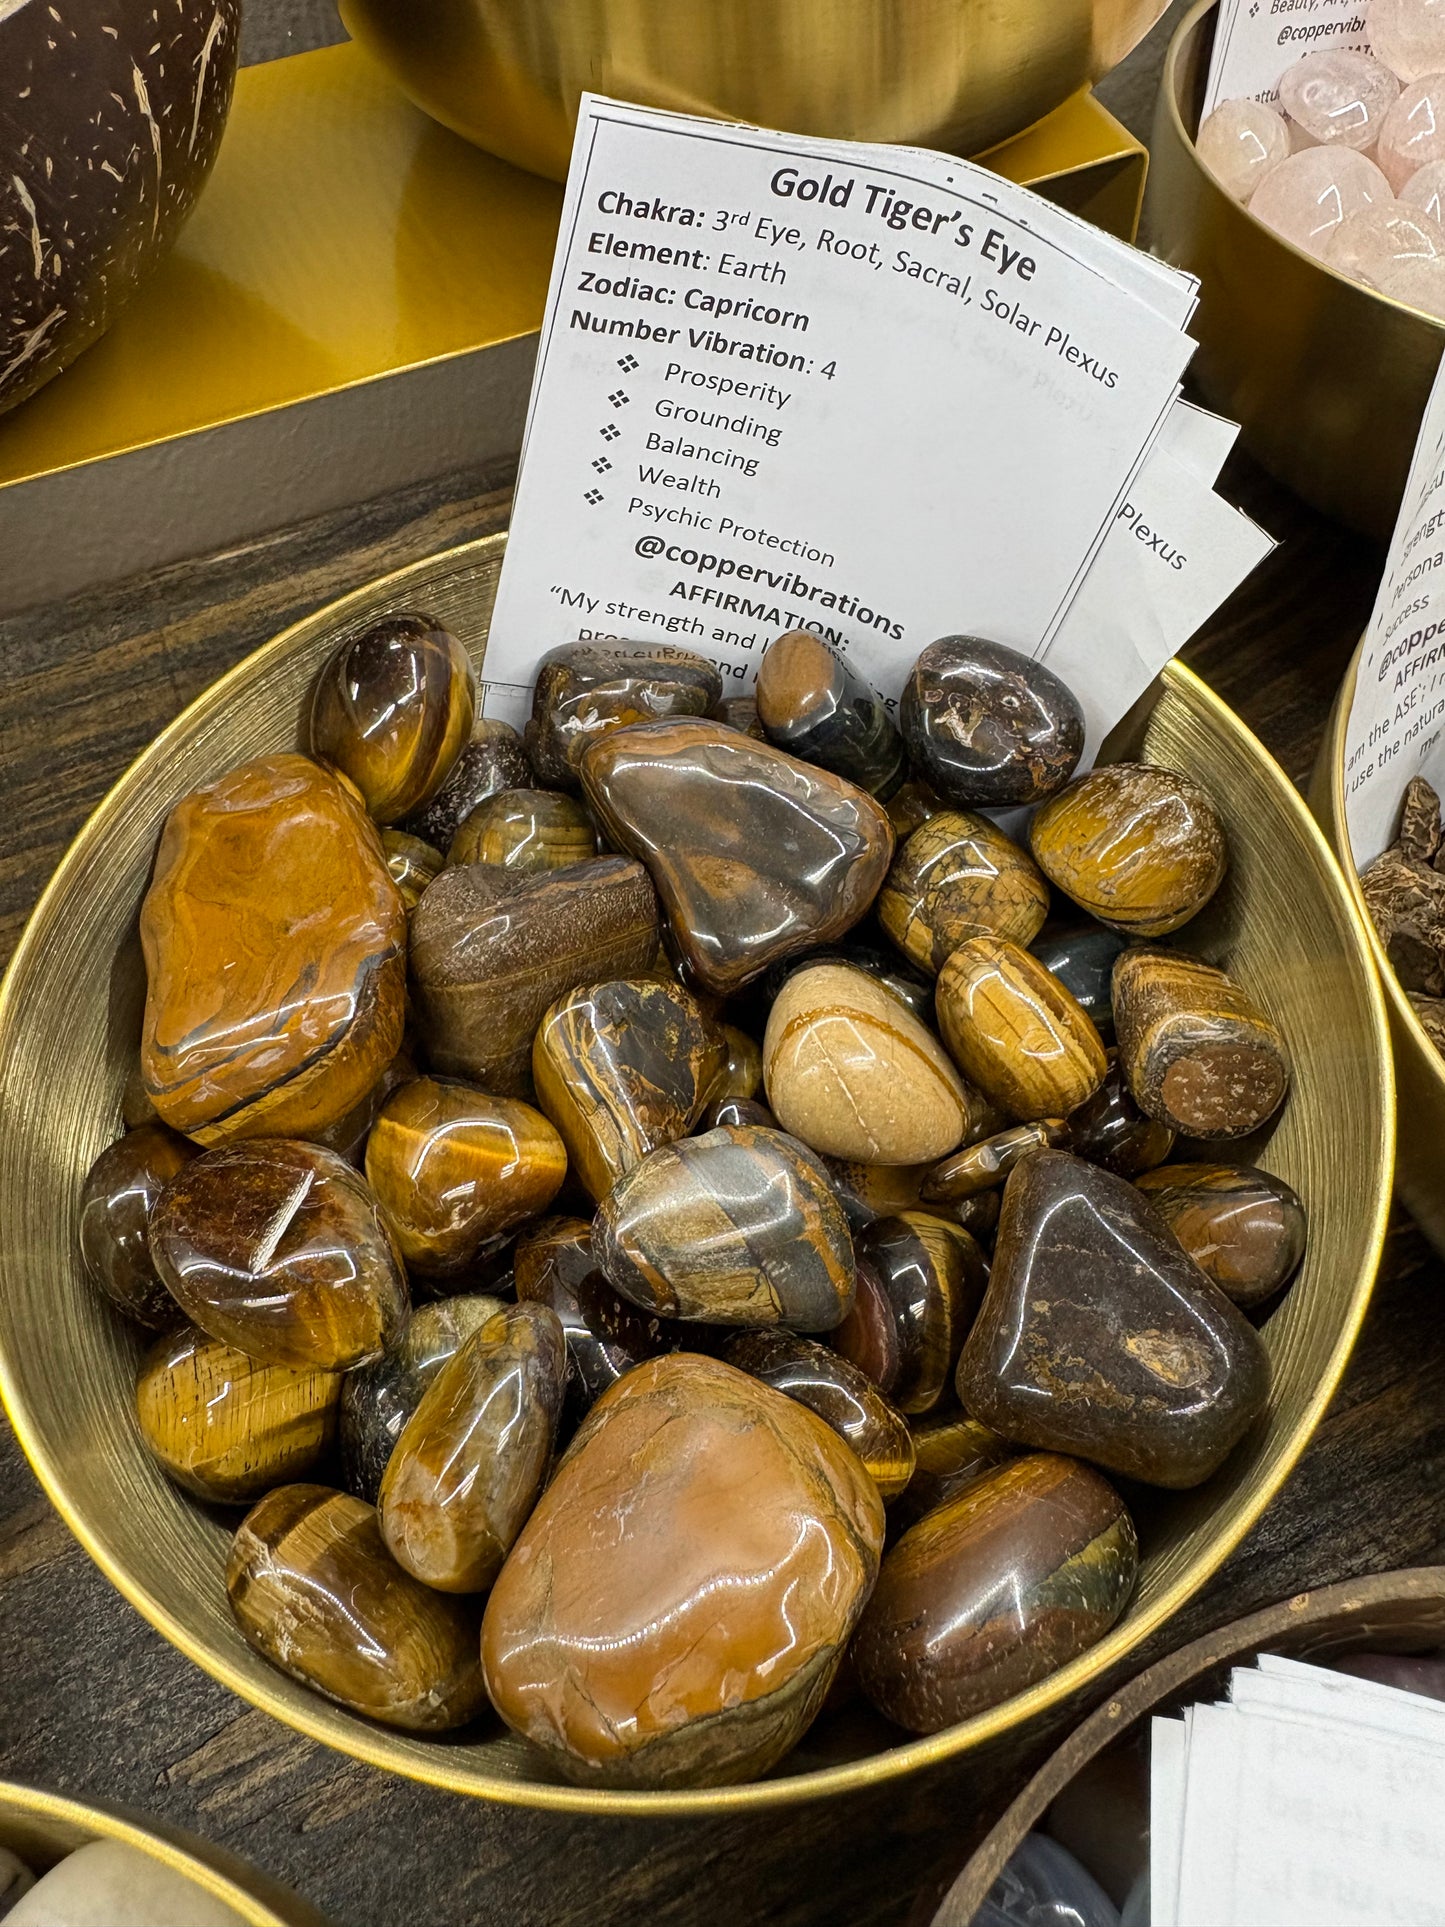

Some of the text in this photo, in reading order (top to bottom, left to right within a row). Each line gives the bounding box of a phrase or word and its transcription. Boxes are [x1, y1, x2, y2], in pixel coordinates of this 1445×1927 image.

[770, 166, 855, 208] Gold
[980, 227, 1037, 282] Eye
[587, 232, 787, 285] Element: Earth
[577, 271, 811, 333] Zodiac: Capricorn
[597, 190, 706, 228] Chakra:
[753, 216, 807, 251] Eye,
[816, 228, 884, 270] Root,
[891, 251, 972, 306] Sacral,
[980, 288, 1042, 338] Solar
[1043, 325, 1120, 390] Plexus
[569, 309, 838, 381] Number Vibration: 4
[663, 362, 793, 410] Prosperity
[654, 398, 784, 447] Grounding
[644, 431, 761, 478] Balancing
[638, 464, 722, 499] Wealth
[627, 497, 836, 568] Psychic Protection
[1116, 501, 1188, 571] Plexus
[634, 535, 906, 642] @coppervibrations
[605, 600, 705, 637] strength
[711, 626, 756, 651] and
[1368, 718, 1391, 748] the
[1351, 763, 1374, 793] use
[1378, 740, 1401, 768] the
